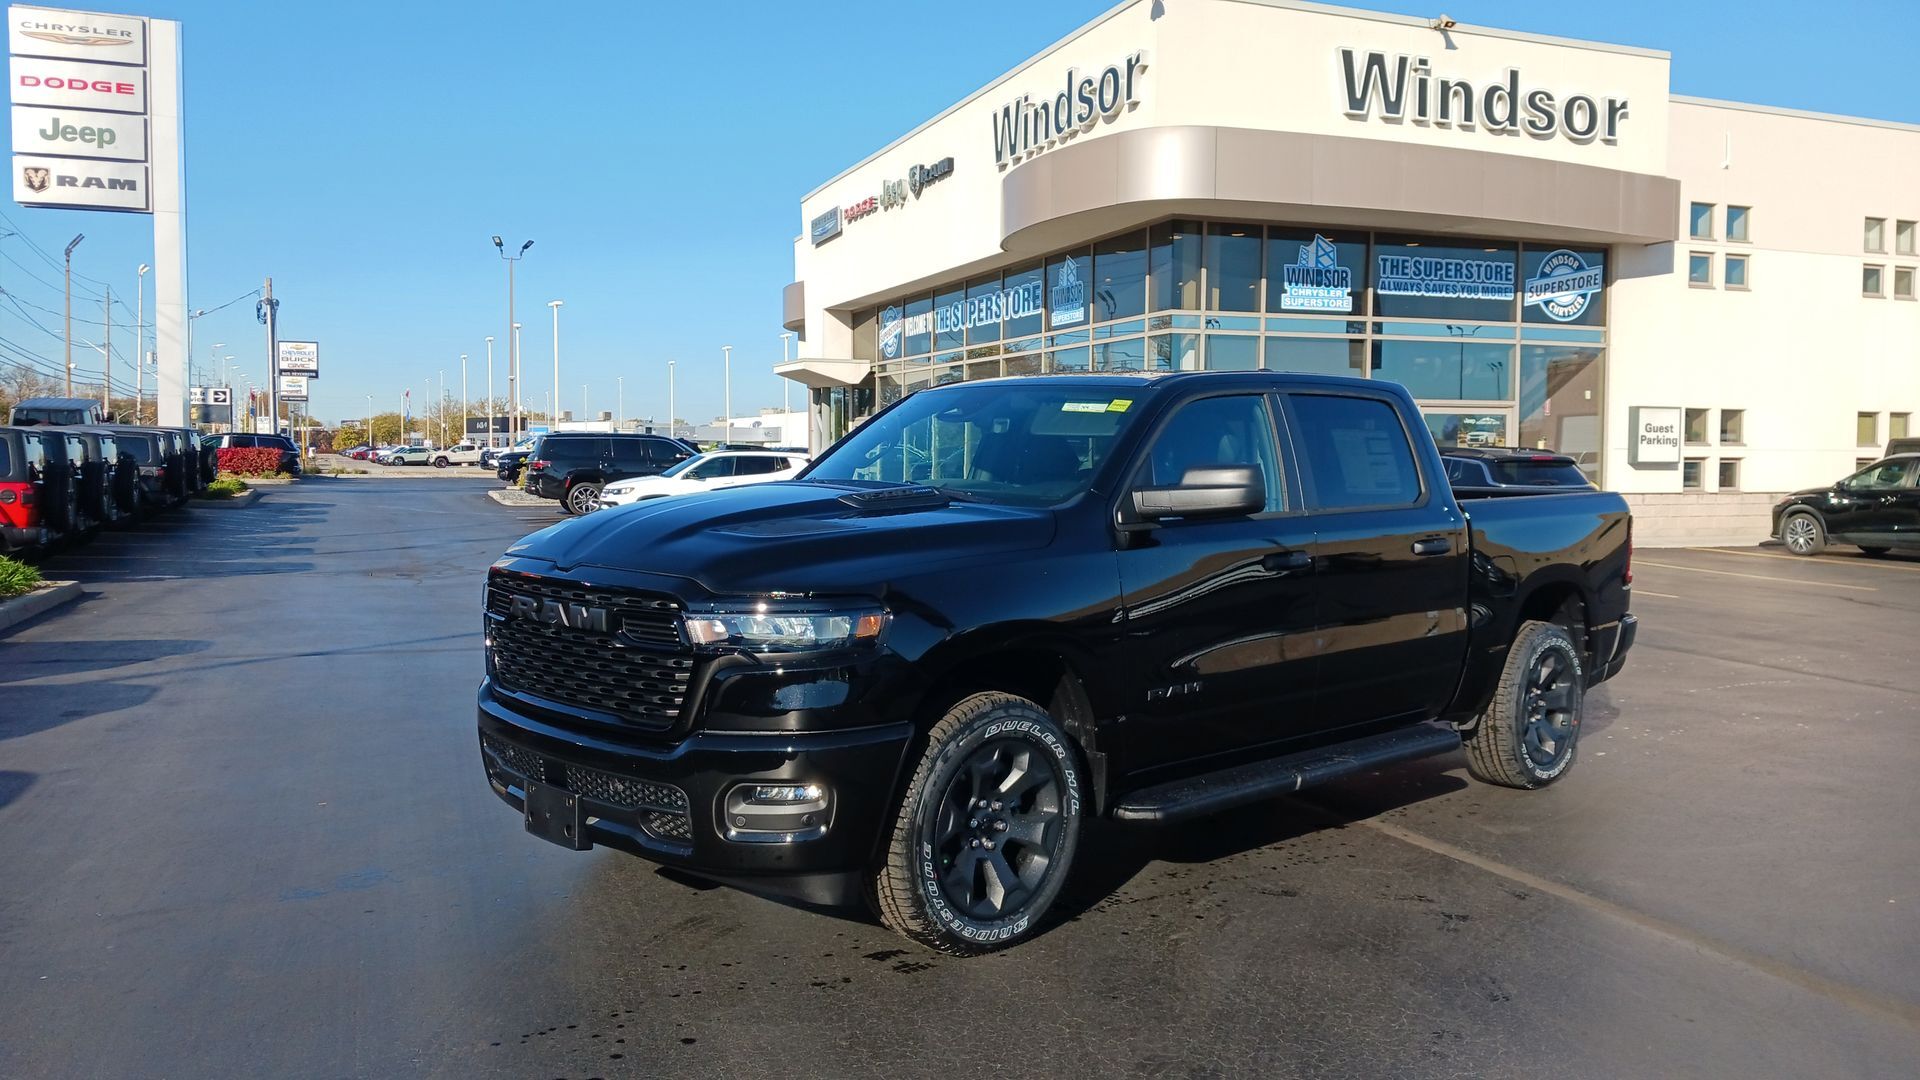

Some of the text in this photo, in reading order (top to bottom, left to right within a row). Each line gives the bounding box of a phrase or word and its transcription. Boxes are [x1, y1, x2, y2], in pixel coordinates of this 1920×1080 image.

[20, 21, 133, 38] CHRYSLER
[20, 75, 135, 95] DODGE
[1337, 46, 1630, 140] Windsor
[992, 50, 1146, 166] Windsor
[39, 117, 116, 148] Jeep
[920, 157, 954, 182] RAM
[56, 174, 137, 192] RAM
[880, 179, 908, 208] Jeep
[844, 196, 878, 220] DODGE
[1380, 258, 1513, 281] THE SUPERSTORE
[1543, 255, 1580, 274] WINDSOR
[1286, 267, 1349, 288] WINDSOR
[1380, 281, 1421, 293] ALWAYS
[1424, 282, 1458, 294] SAVES
[1461, 284, 1479, 296] YOU
[1529, 273, 1599, 298] SUPERSTORE
[1053, 283, 1082, 306] WINDSOR
[1284, 297, 1351, 309] SUPERSTORE
[1291, 288, 1343, 298] CHRYSLER
[935, 308, 950, 333] THE
[951, 283, 1042, 331] SUPERSTORE
[1548, 296, 1585, 317] CHRYSLER
[1645, 423, 1674, 433] Guest
[1640, 435, 1678, 447] Parking
[510, 594, 608, 633] RAM
[984, 720, 1065, 760] DUELER
[923, 841, 1029, 942] BRIDGESTONE
